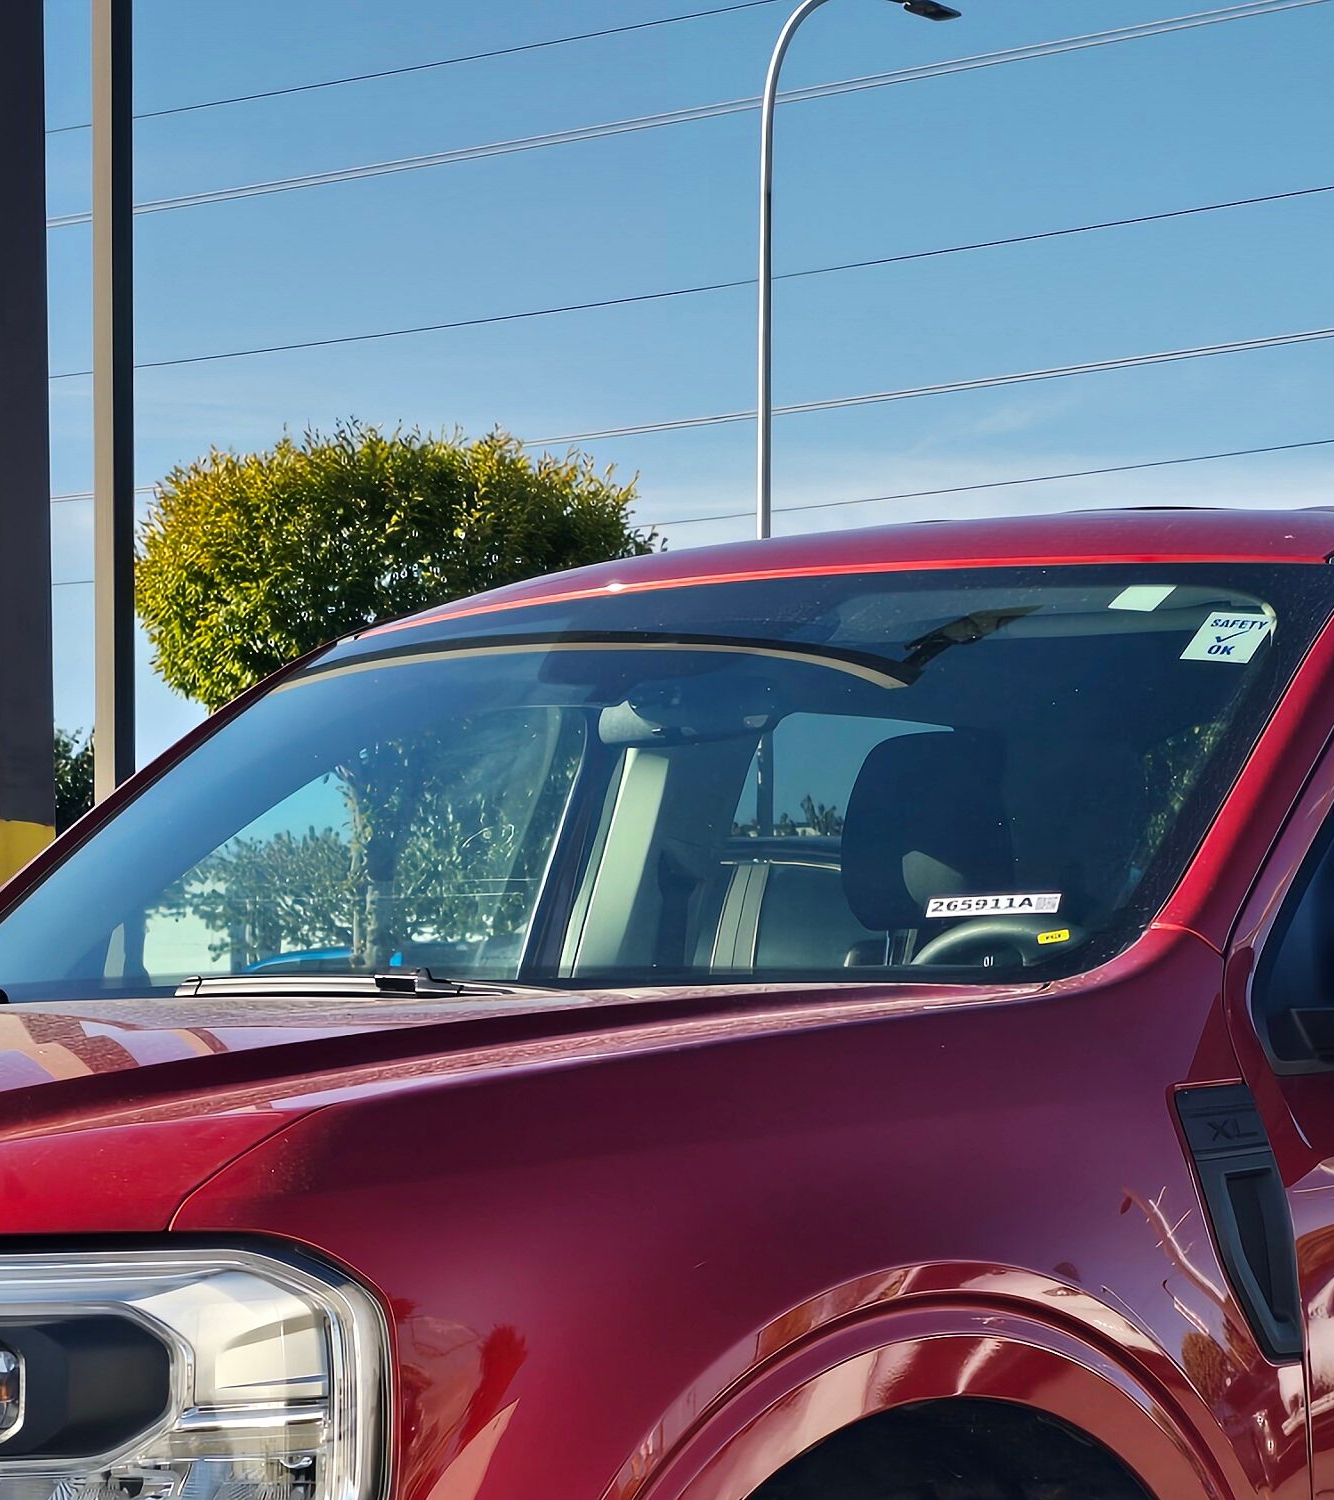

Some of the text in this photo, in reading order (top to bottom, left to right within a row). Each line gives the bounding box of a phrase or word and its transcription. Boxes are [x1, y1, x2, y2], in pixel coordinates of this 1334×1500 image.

[1211, 619, 1269, 630] SAFETY
[1207, 645, 1235, 655] OK
[931, 897, 1033, 912] 265911A
[1207, 1119, 1259, 1142] XL
